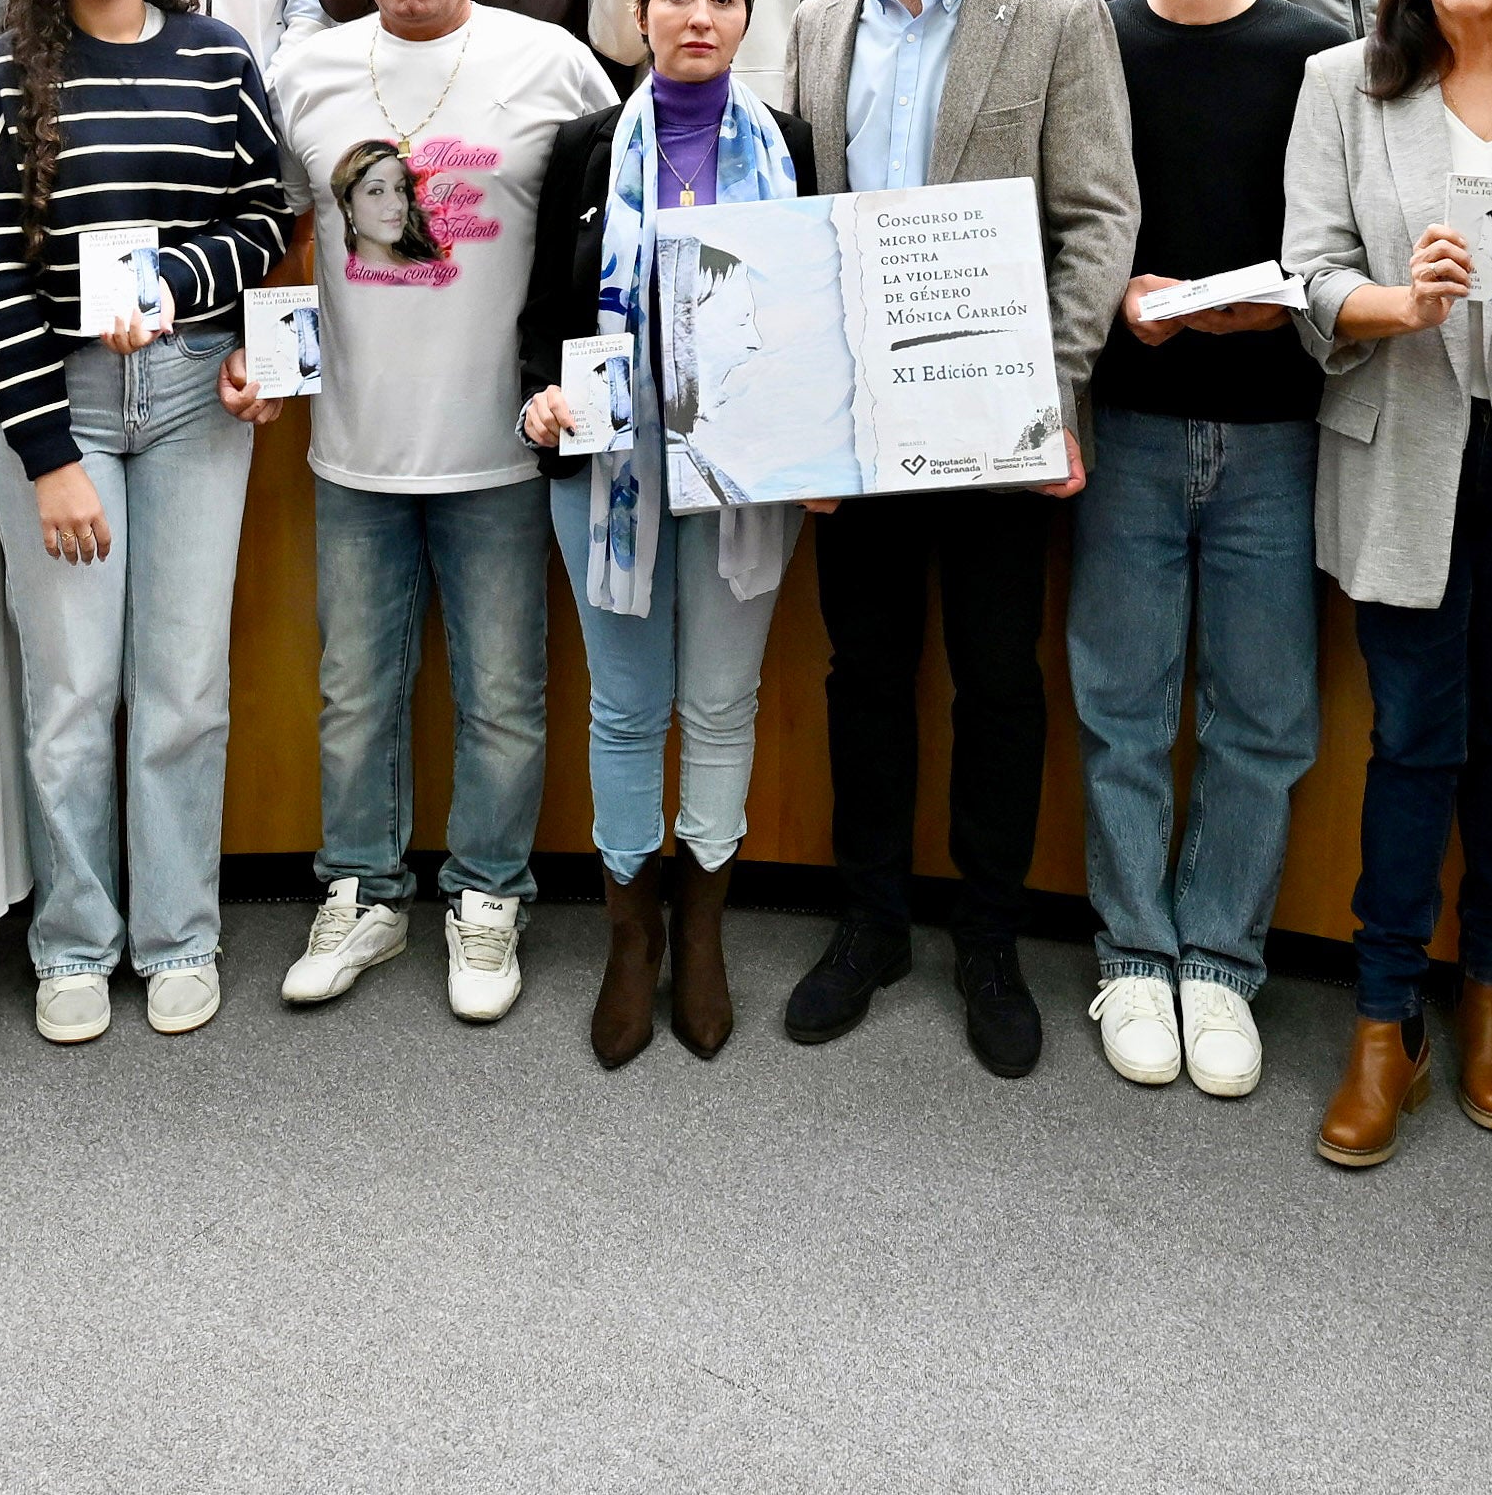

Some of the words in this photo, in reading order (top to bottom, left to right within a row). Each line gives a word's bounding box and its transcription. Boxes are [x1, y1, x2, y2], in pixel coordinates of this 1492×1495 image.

[412, 141, 497, 168] Mónica
[425, 183, 483, 210] Mujer
[432, 216, 499, 238] Valiente
[877, 213, 958, 227] CONCURSO
[964, 210, 984, 220] DE
[879, 234, 926, 247] MICRO
[932, 228, 997, 243] RELATOS
[881, 253, 939, 265] CONTRA
[345, 258, 397, 282] Estamos
[404, 264, 459, 285] contigo
[883, 275, 901, 285] LA
[906, 267, 989, 282] VIOLENCIA
[885, 293, 905, 303] DE
[909, 286, 971, 302] GÉNERO
[893, 367, 915, 383] XI
[923, 363, 988, 381] Edición
[995, 363, 1035, 377] 2025
[930, 457, 977, 467] Diputación
[943, 465, 981, 474] Granada
[482, 902, 502, 910] FILA
